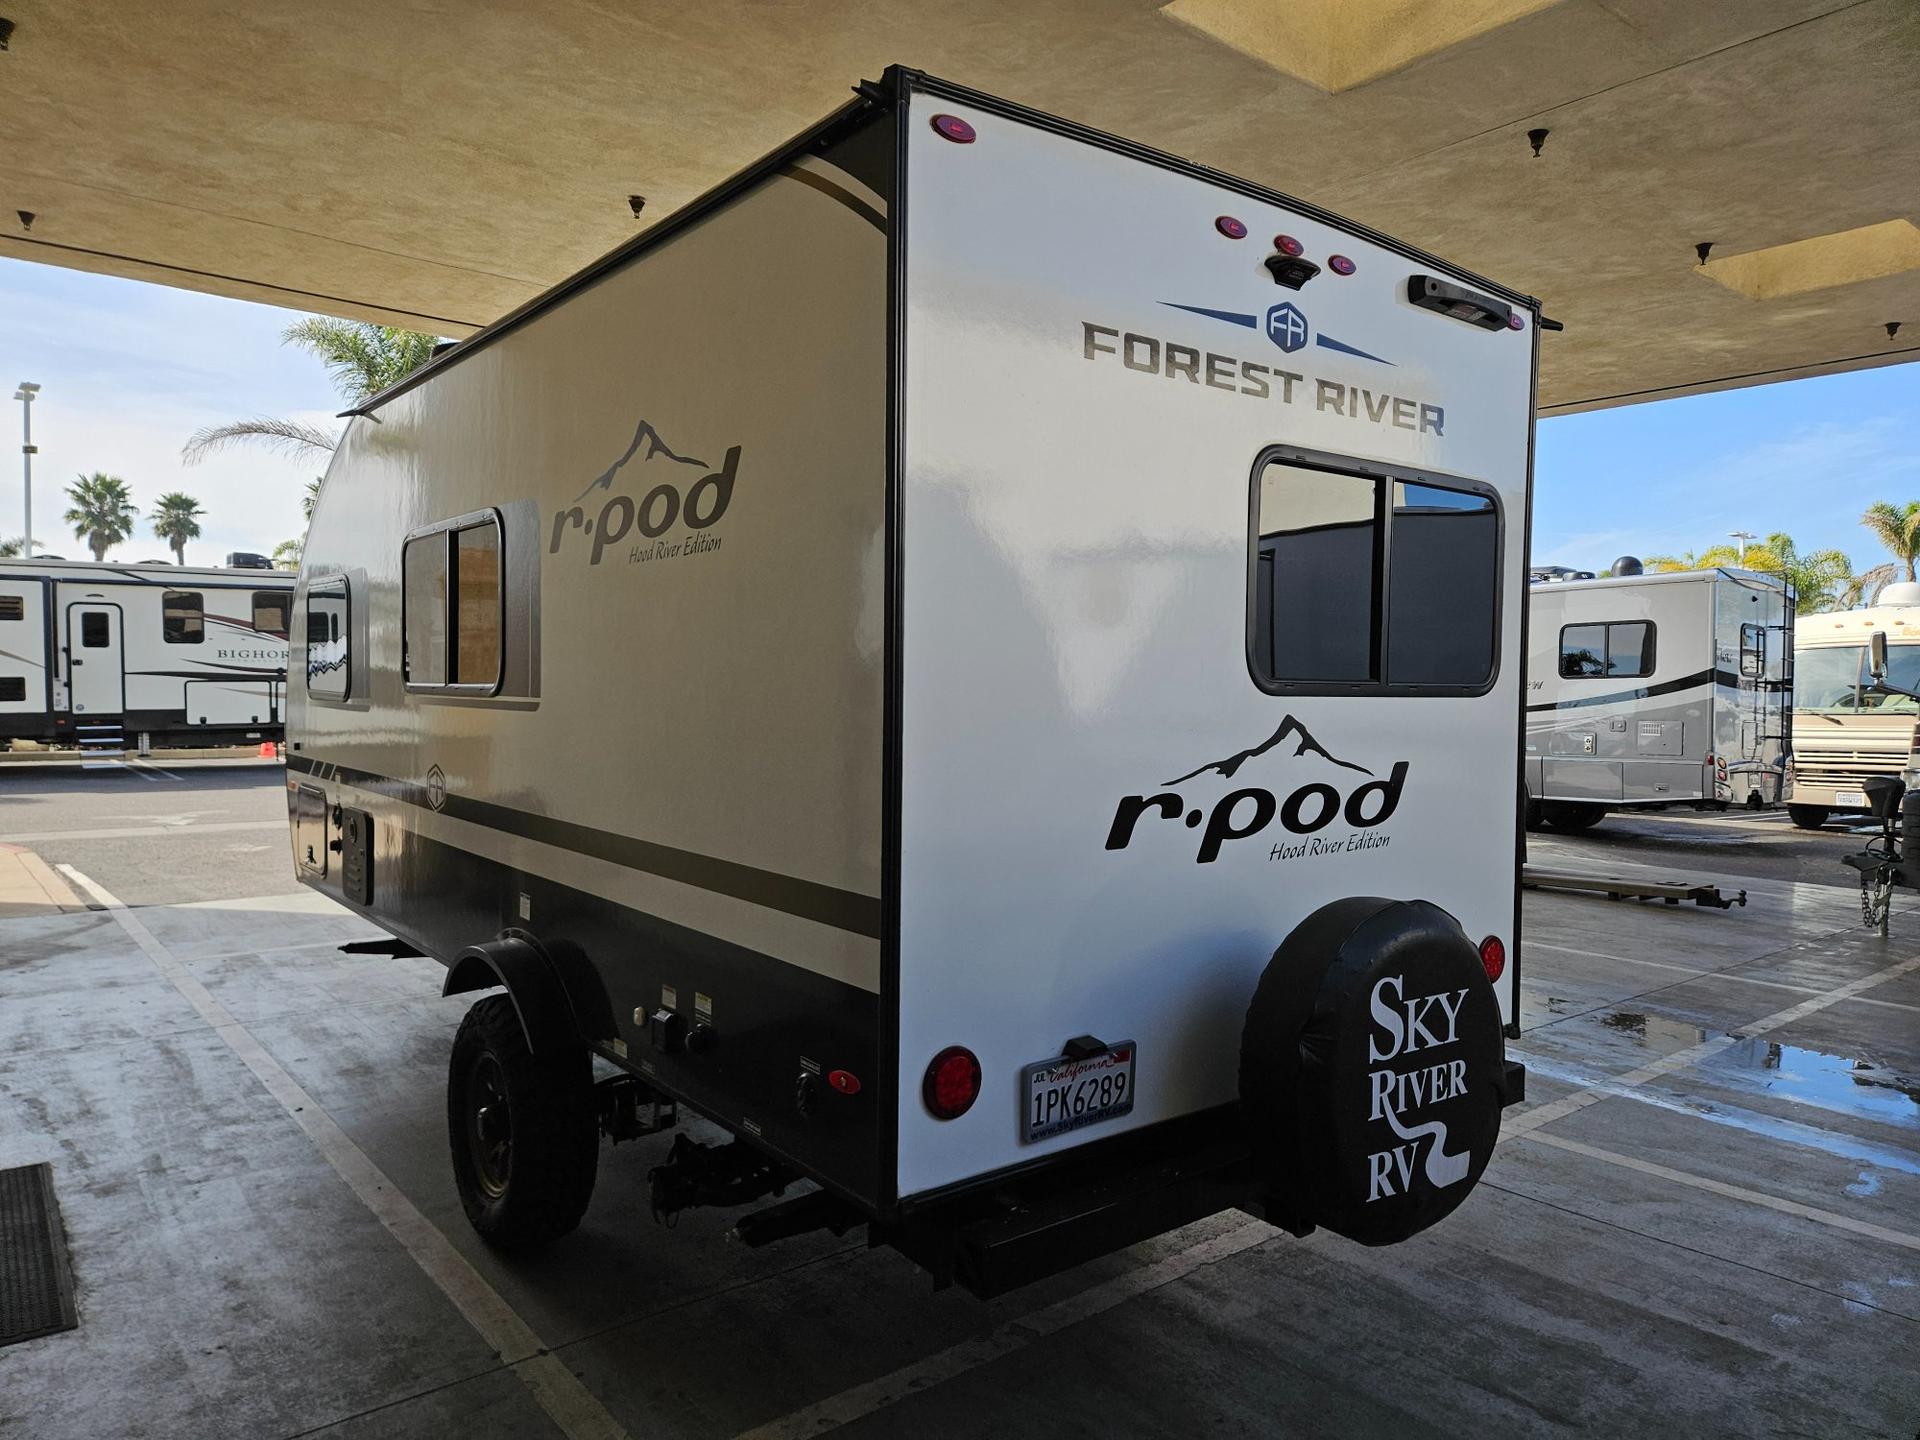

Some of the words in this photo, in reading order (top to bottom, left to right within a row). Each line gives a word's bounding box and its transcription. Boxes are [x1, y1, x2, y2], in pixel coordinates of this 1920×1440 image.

[1081, 320, 1304, 404] FOREST
[1315, 377, 1445, 437] RIVER
[629, 540, 656, 565] Hood
[655, 540, 682, 560] River
[683, 531, 722, 557] Edition
[1269, 835, 1309, 861] Hood
[1309, 837, 1345, 857] River
[1346, 829, 1390, 852] Edition
[1032, 1072, 1126, 1128] 1PK6289
[1367, 1059, 1469, 1122] RIVER
[1366, 1141, 1419, 1203] RV
